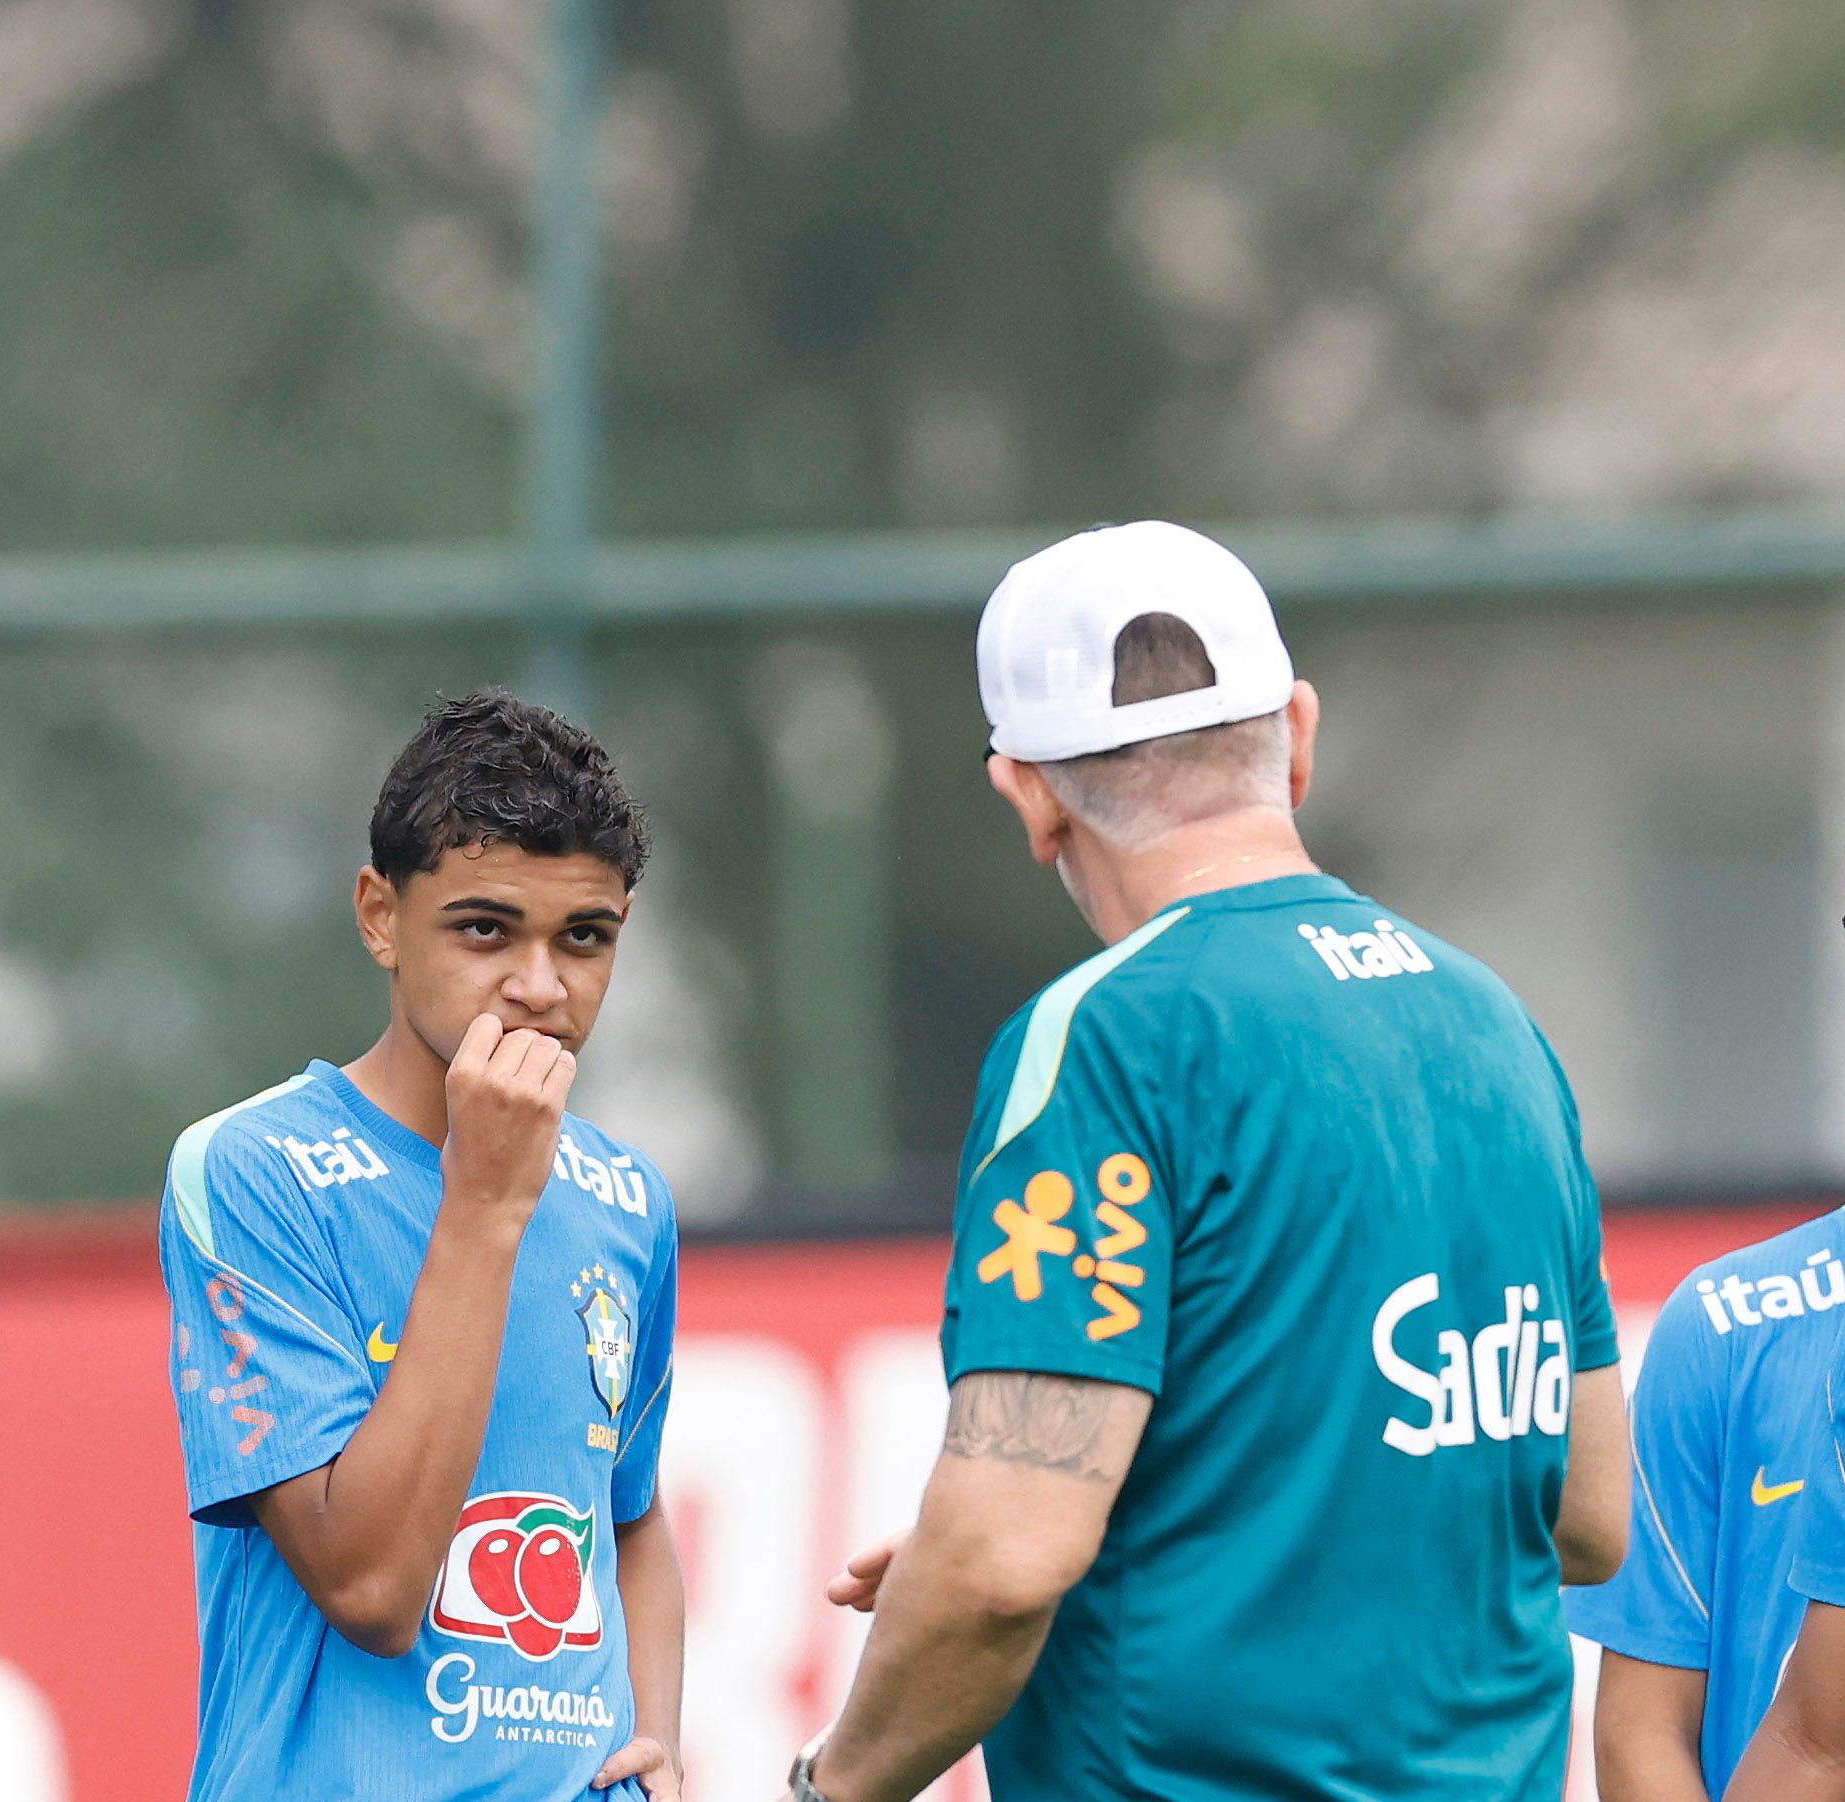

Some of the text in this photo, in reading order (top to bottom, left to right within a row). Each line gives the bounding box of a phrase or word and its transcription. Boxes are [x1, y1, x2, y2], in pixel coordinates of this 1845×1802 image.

[1298, 919, 1435, 982] itaú
[266, 1126, 390, 1193] itaú
[1072, 1152, 1152, 1341] vivo
[207, 1272, 277, 1457] vivo
[1371, 1271, 1571, 1457] Sadia
[426, 1652, 615, 1744] Guaraná
[495, 1725, 598, 1748] ANTARCTICA
